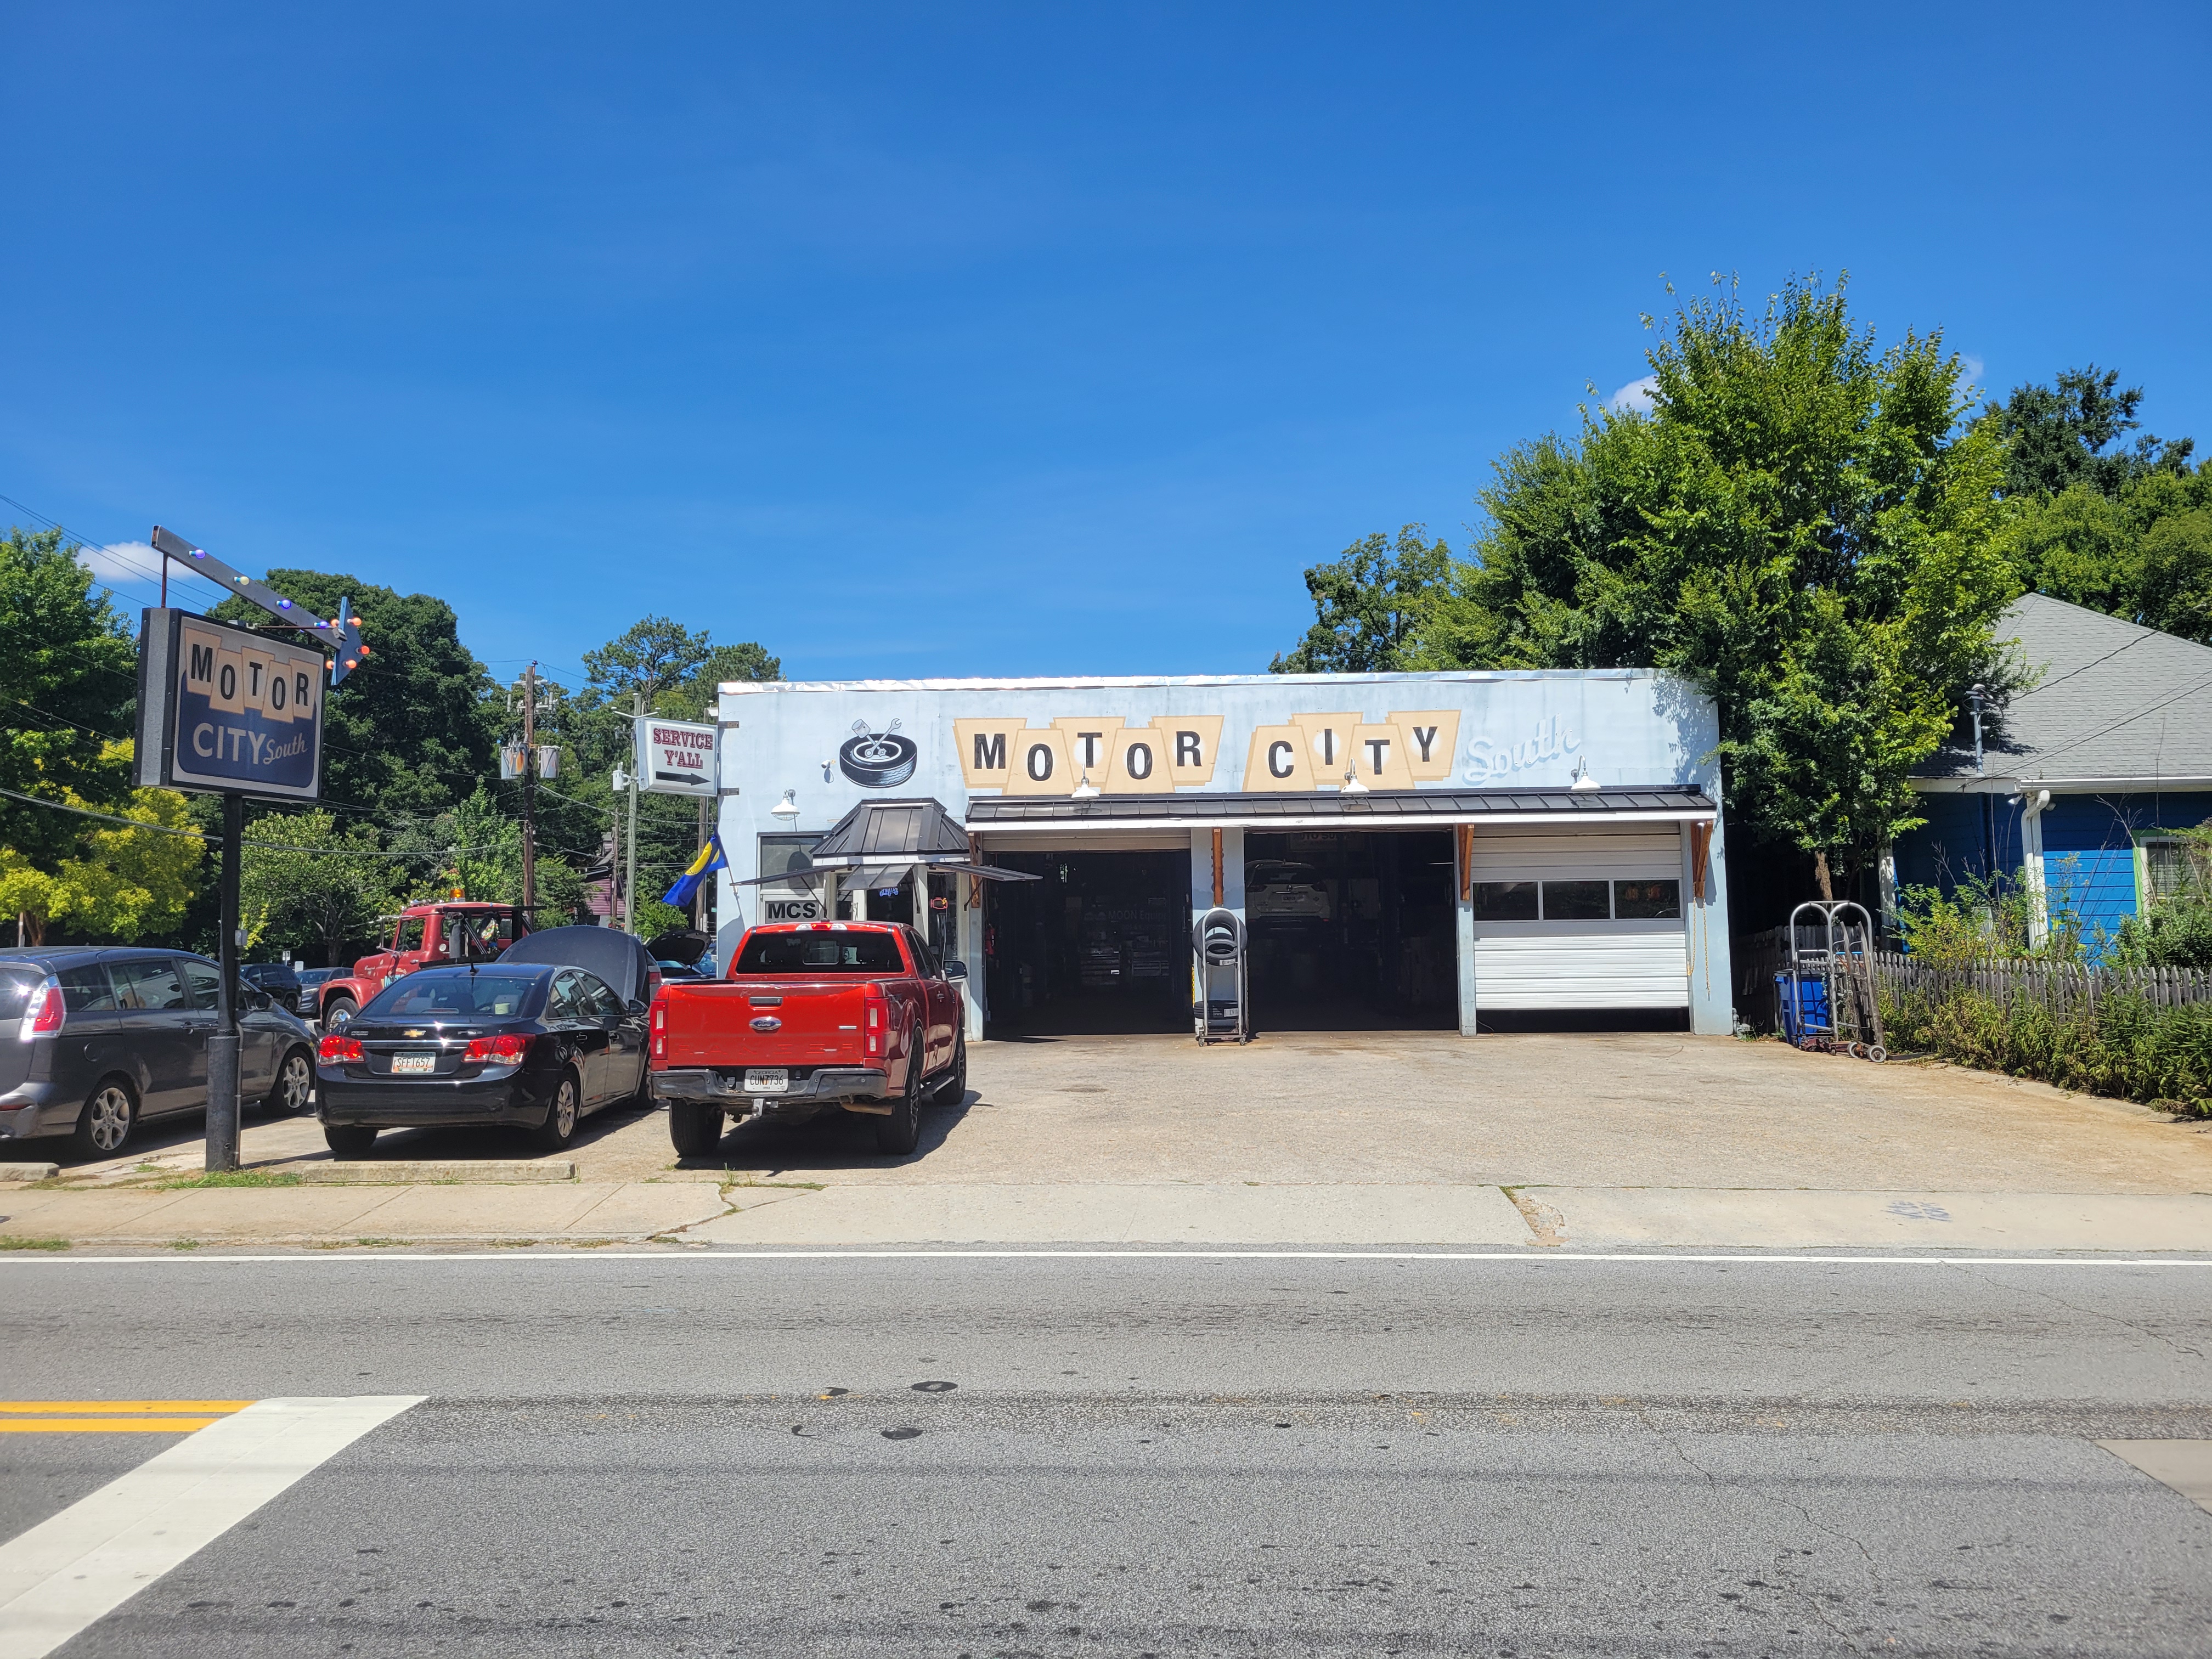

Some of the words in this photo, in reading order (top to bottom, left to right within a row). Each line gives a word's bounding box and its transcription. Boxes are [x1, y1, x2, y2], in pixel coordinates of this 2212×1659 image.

[190, 644, 309, 710] MOTOR
[193, 723, 267, 764] CITY
[263, 732, 308, 765] South
[653, 728, 713, 750] SERVICE
[664, 749, 703, 769] Y'ALL
[974, 731, 1203, 781] MOTOR
[1268, 726, 1438, 778] CITY
[1462, 713, 1581, 786] South
[768, 902, 816, 919] MCS
[1108, 910, 1137, 919] MOON
[397, 1058, 430, 1067] SFF1657
[750, 1075, 783, 1085] CUN7736
